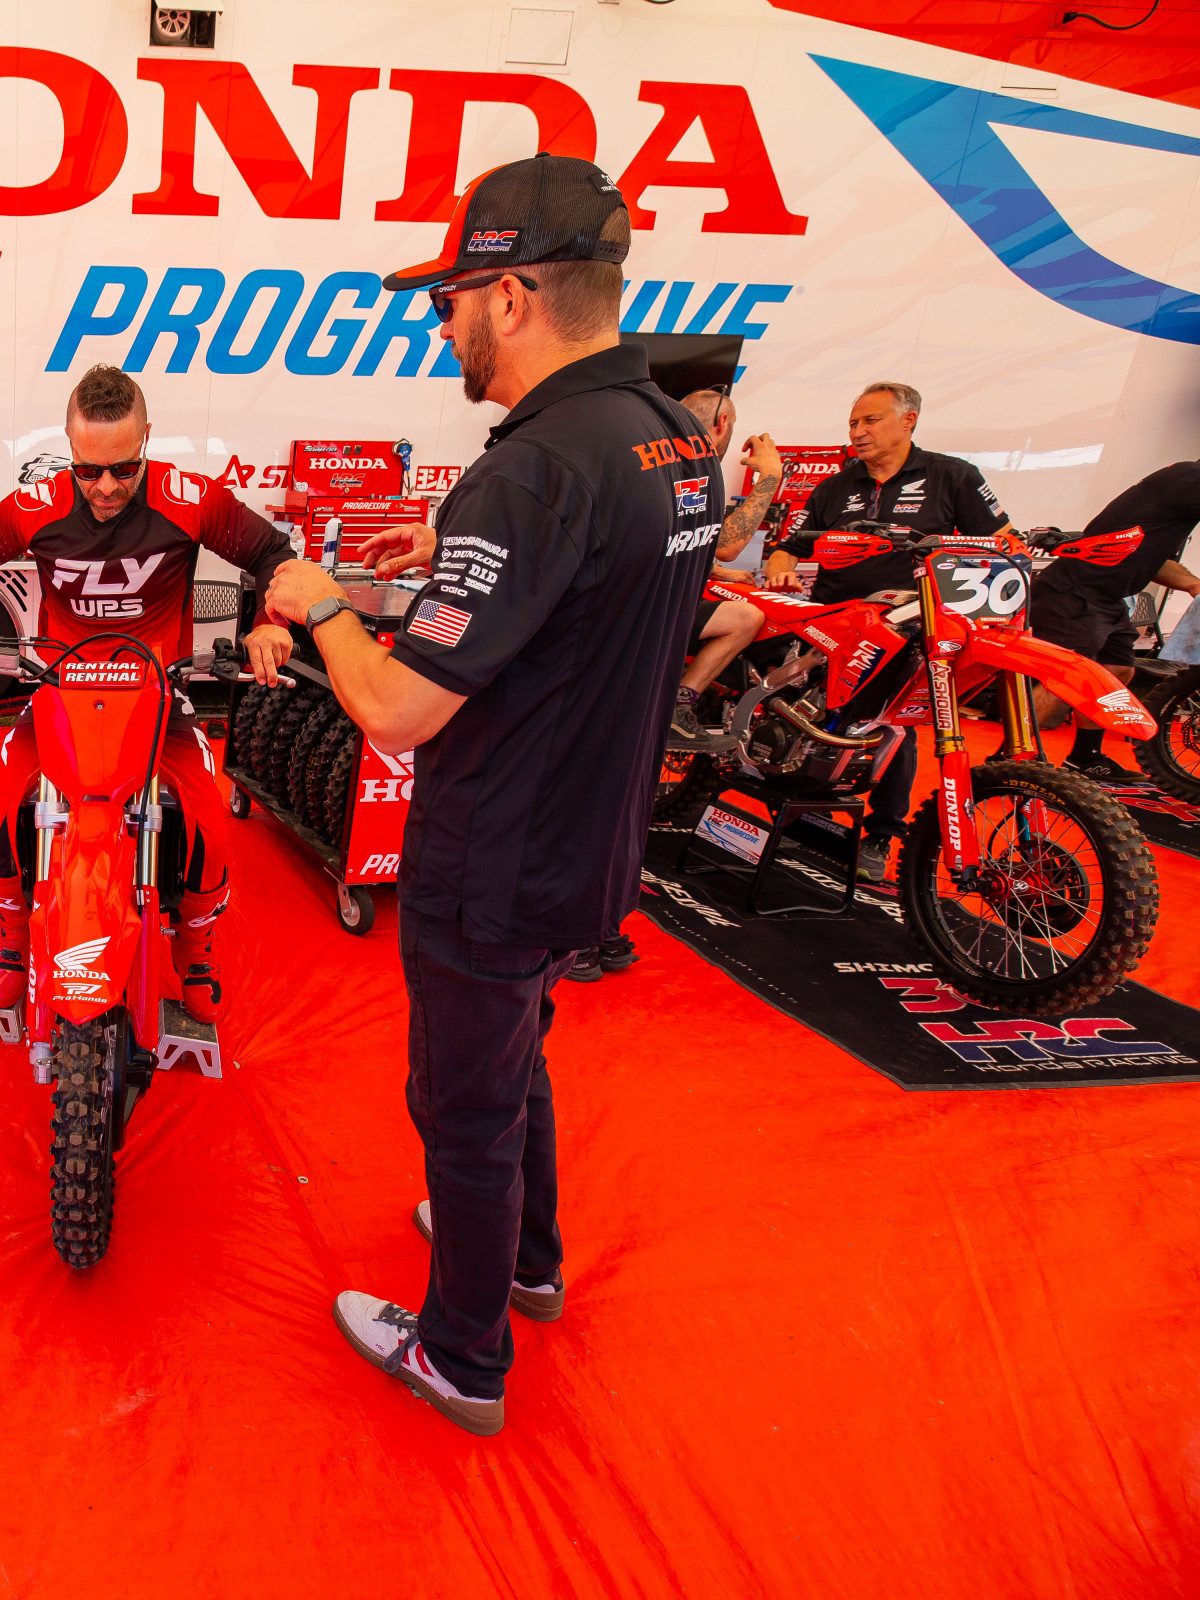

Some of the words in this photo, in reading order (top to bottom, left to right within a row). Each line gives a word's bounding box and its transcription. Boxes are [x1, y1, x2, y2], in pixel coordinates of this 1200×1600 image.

[469, 230, 519, 249] HRC
[45, 264, 794, 384] PROGRIVE
[309, 458, 388, 470] HONDA
[632, 435, 720, 471] HONDA
[416, 468, 460, 490] ヨシムラ
[341, 502, 392, 510] PROGRESSIVE
[451, 550, 503, 569] DUNLOP
[52, 552, 167, 596] FLY
[710, 584, 749, 603] HONDA
[943, 567, 1031, 615] 30
[70, 598, 145, 618] WPS
[803, 625, 840, 652] PROGRESSIVE
[65, 672, 140, 682] RENTHAL
[933, 680, 953, 730] SHOWA
[1103, 706, 1147, 716] HONDA
[1008, 779, 1066, 805] DUNLOP
[711, 808, 760, 837] HONDA
[944, 777, 961, 851] DUNLOP
[723, 823, 760, 845] PROGRESSIVE
[53, 970, 112, 981] HONDA
[919, 1017, 1181, 1062] HRC
[975, 1059, 1084, 1072] Honda
[1084, 1054, 1198, 1068] RACING
